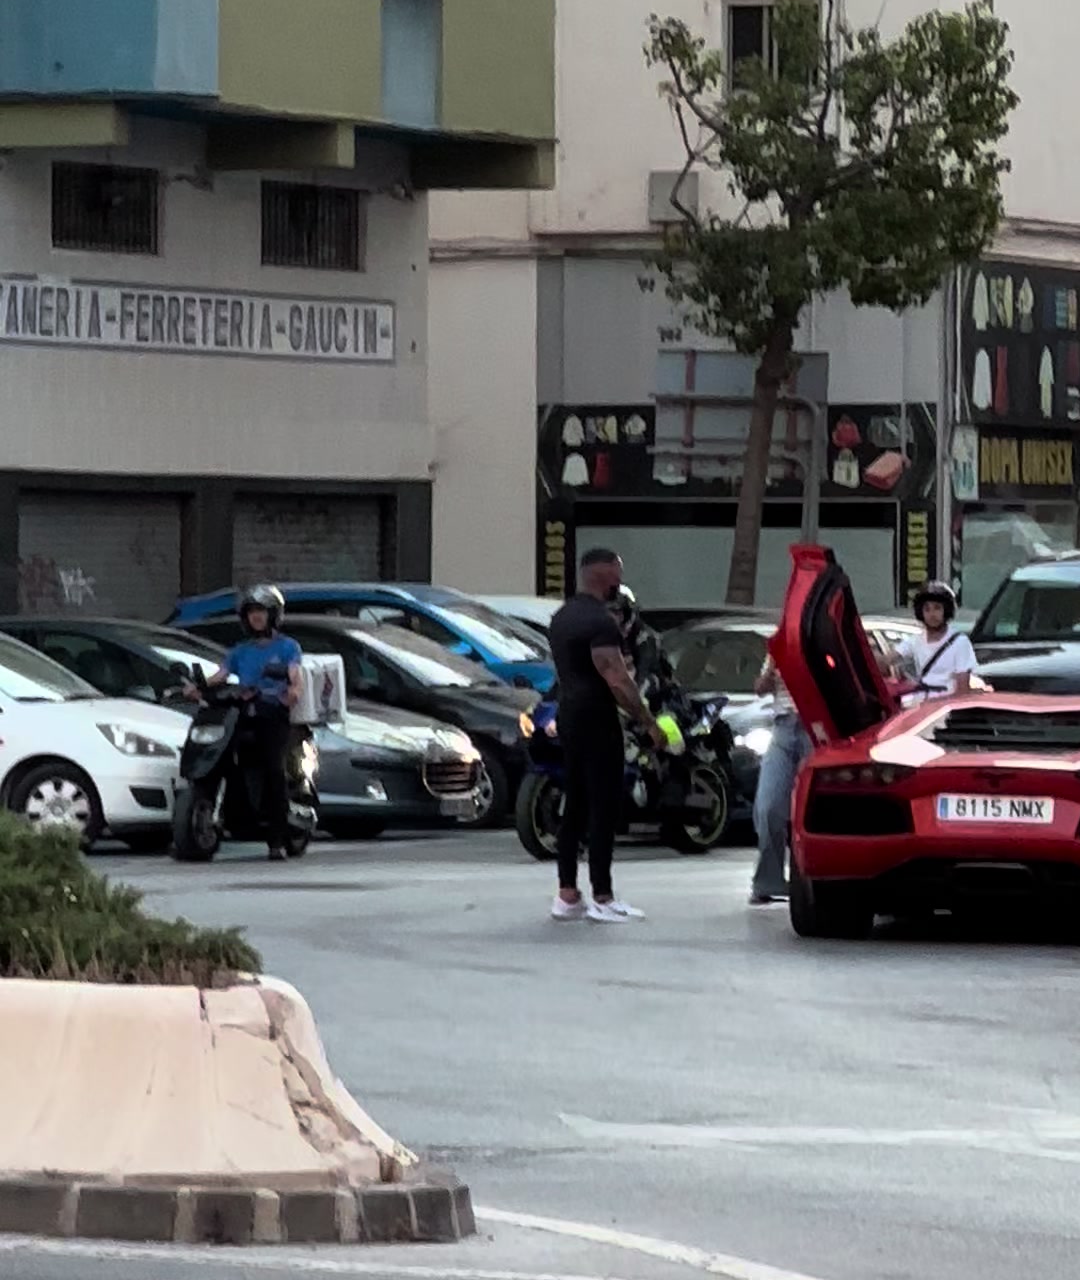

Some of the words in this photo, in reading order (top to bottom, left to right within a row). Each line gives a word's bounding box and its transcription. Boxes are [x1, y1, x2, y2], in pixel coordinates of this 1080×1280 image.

[1022, 439, 1073, 485] UNISEX
[955, 798, 1002, 817] 8115
[1009, 799, 1045, 818] NMX
